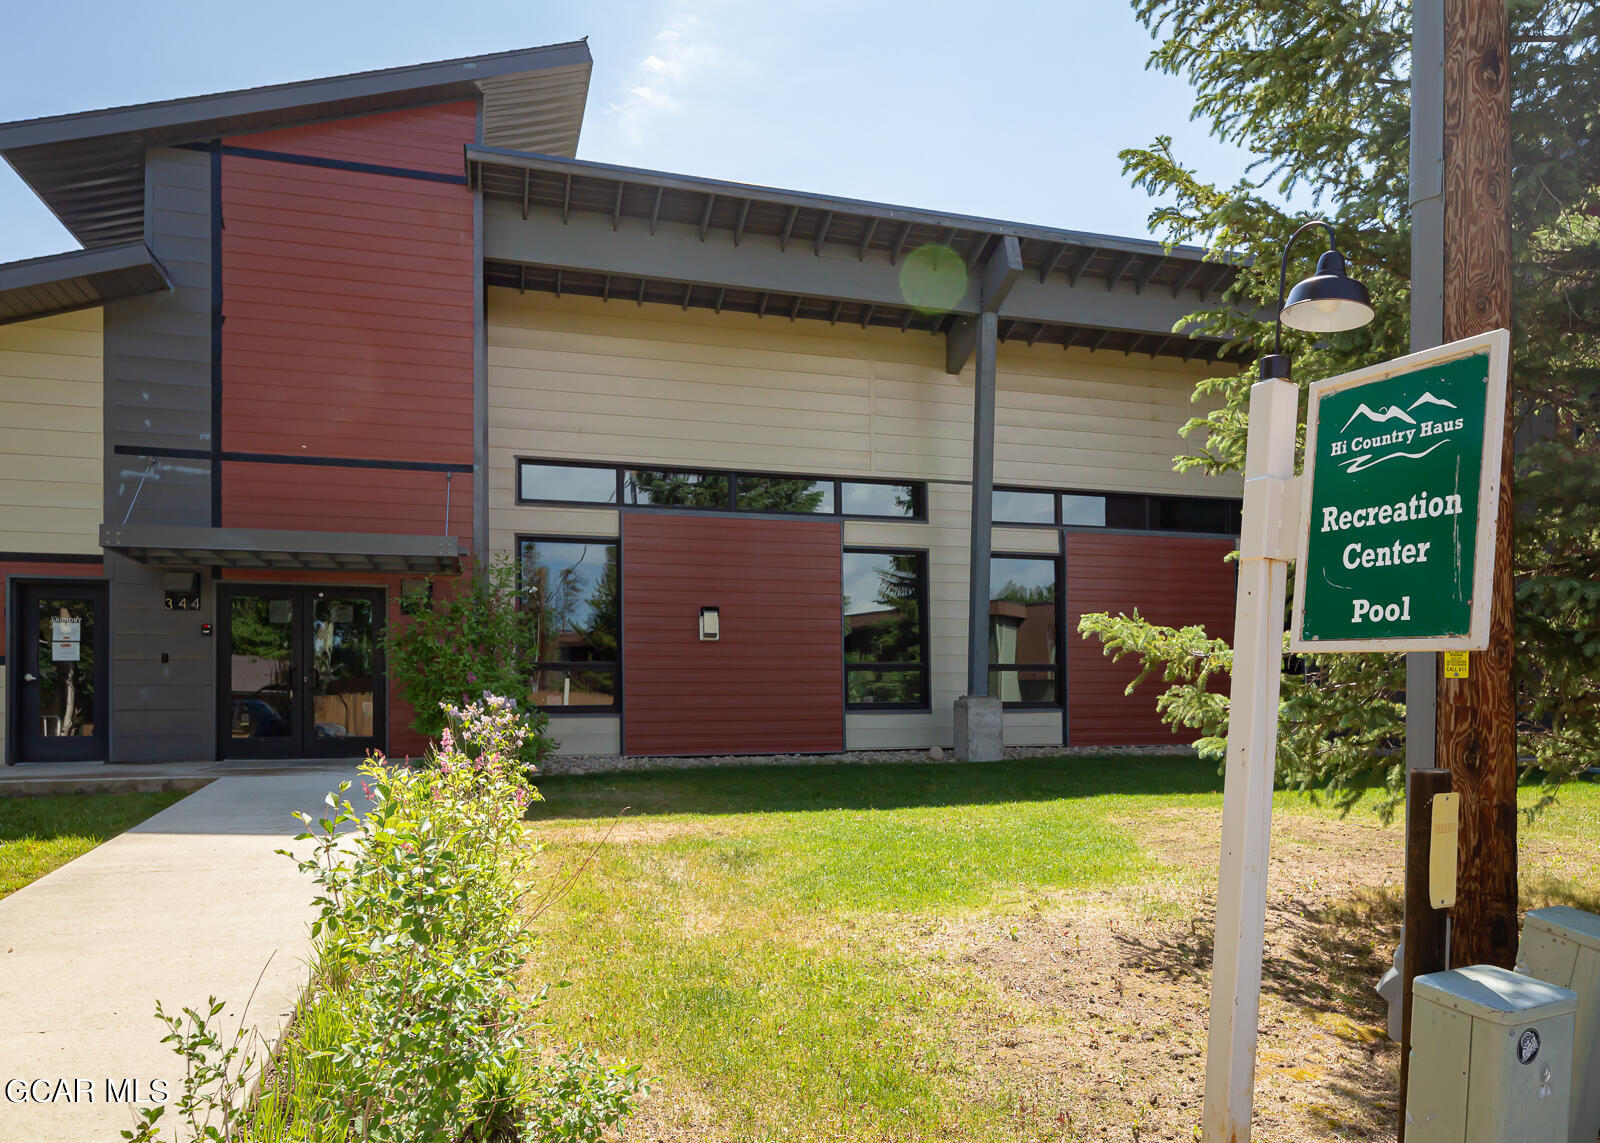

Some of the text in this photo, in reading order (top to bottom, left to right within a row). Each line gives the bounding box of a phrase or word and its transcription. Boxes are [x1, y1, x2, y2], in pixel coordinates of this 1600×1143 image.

[1330, 417, 1464, 457] Hi Country Haus
[1320, 490, 1463, 533] Recreation
[1342, 538, 1431, 570] Center
[164, 597, 200, 610] 344
[1351, 595, 1411, 623] Pool
